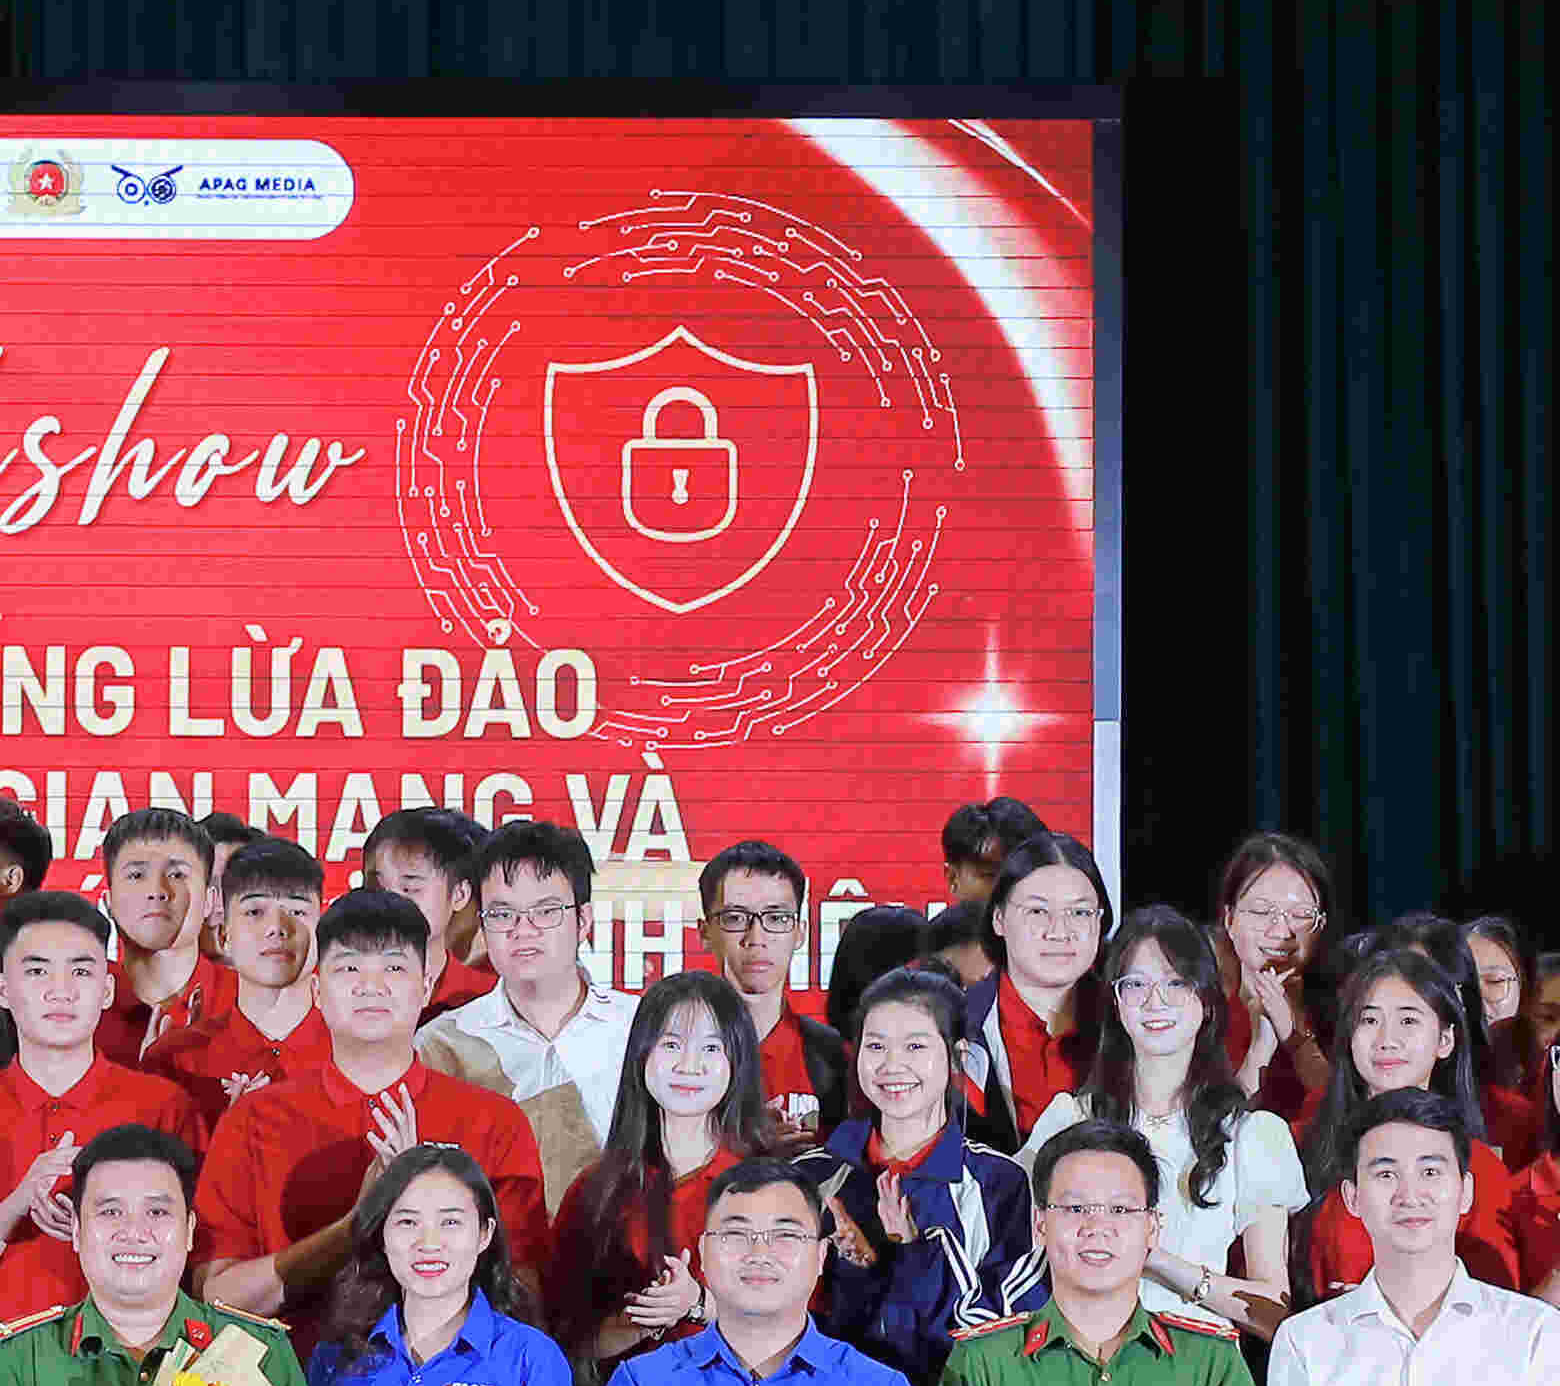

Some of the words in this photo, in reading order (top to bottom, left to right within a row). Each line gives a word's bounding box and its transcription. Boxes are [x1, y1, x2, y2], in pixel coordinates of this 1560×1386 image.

[199, 177, 248, 191] APAG
[255, 177, 316, 191] MEDIA
[168, 623, 364, 739] LỪA
[396, 617, 598, 739] ĐẢO
[564, 751, 693, 862] VÀ
